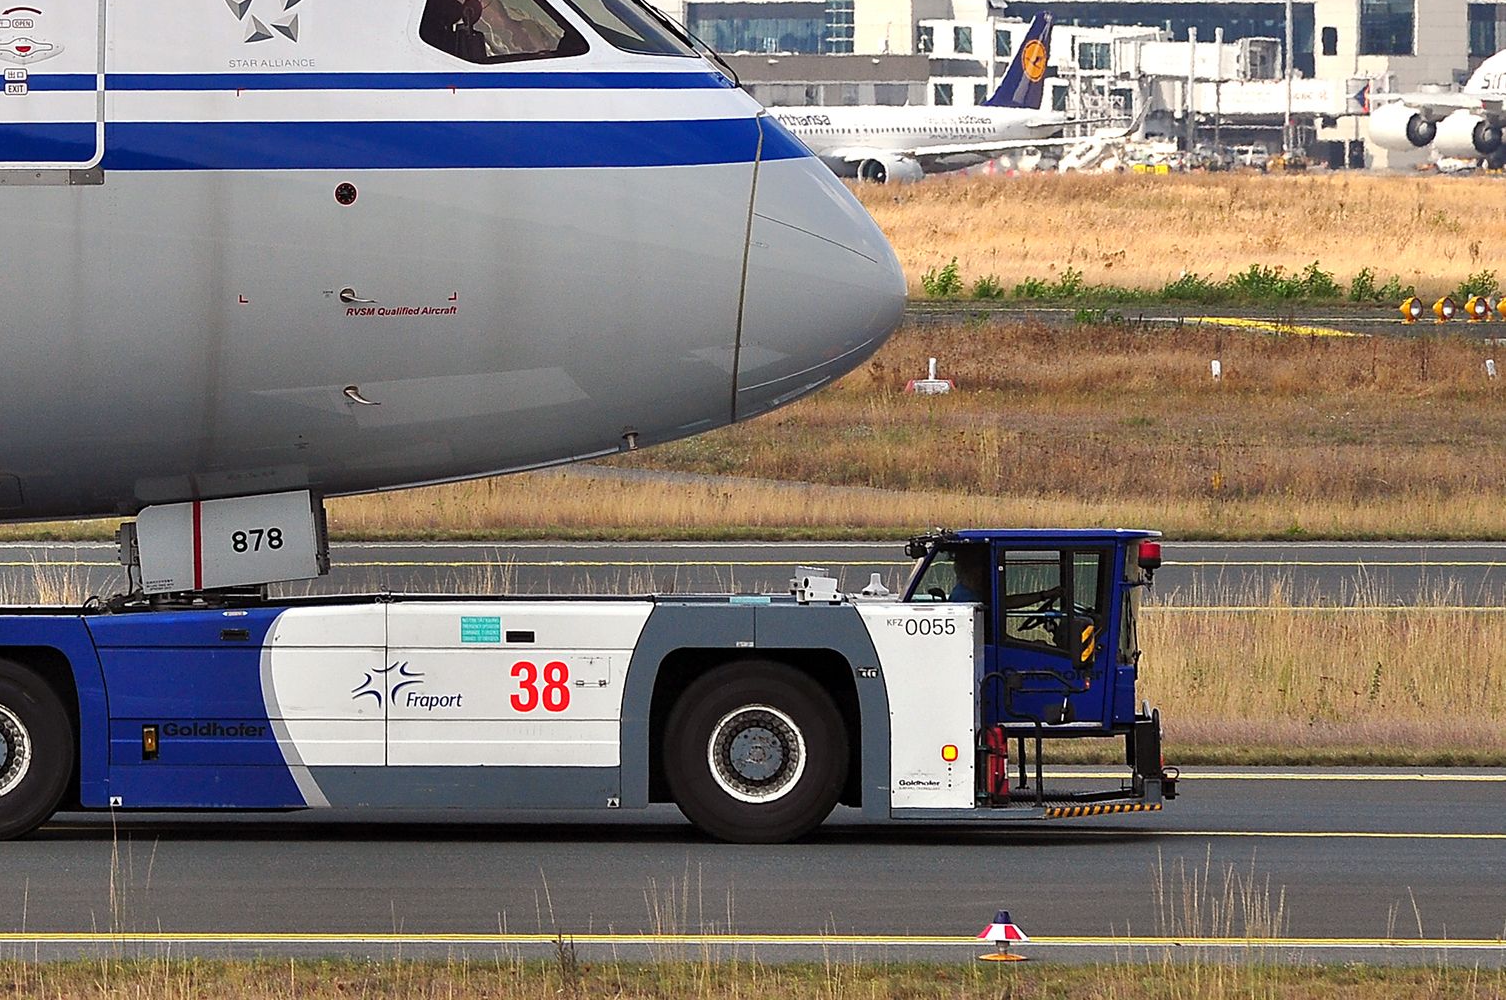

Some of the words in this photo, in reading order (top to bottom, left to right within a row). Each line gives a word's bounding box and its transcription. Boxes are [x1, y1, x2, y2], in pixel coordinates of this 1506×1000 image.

[228, 59, 258, 68] STAR
[260, 58, 316, 68] ALLIANCE
[7, 71, 24, 79] 出口
[8, 85, 24, 93] EXIT
[346, 307, 375, 316] RVSM
[377, 306, 420, 316] Qualified
[421, 306, 457, 315] Aircraft
[232, 527, 284, 553] 878
[886, 619, 903, 627] KFZ
[905, 618, 956, 635] 0055
[510, 661, 570, 712] 38
[406, 691, 463, 711] Fraport
[162, 722, 266, 737] Goldhofer
